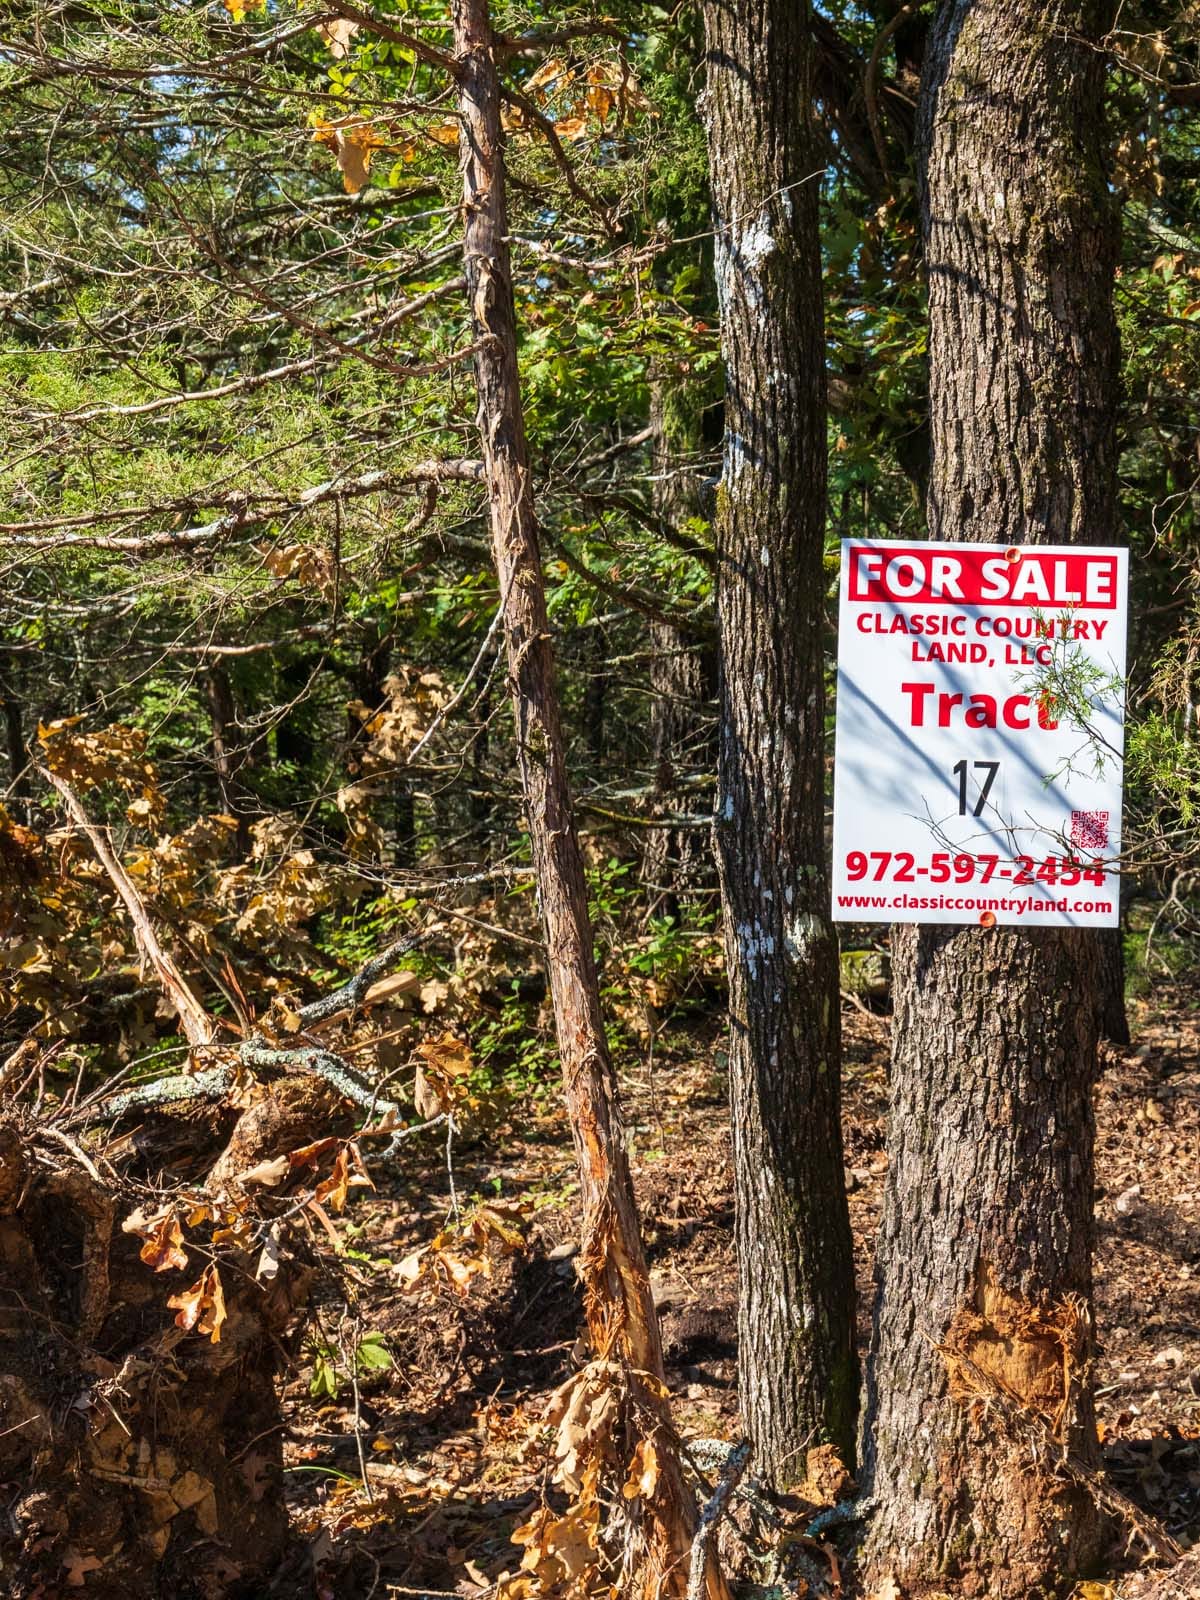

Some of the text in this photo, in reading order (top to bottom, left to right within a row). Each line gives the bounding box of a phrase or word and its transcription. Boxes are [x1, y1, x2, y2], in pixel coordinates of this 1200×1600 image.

[856, 554, 1112, 603] FOR SALE
[856, 613, 1108, 640] CLASSIC COUNTRY
[912, 641, 1053, 667] LAND, LLC
[902, 682, 1058, 730] Tract
[953, 759, 1000, 817] 17
[846, 851, 1106, 886] 972-597-2454
[838, 893, 1112, 915] www.classiccountryland.com
